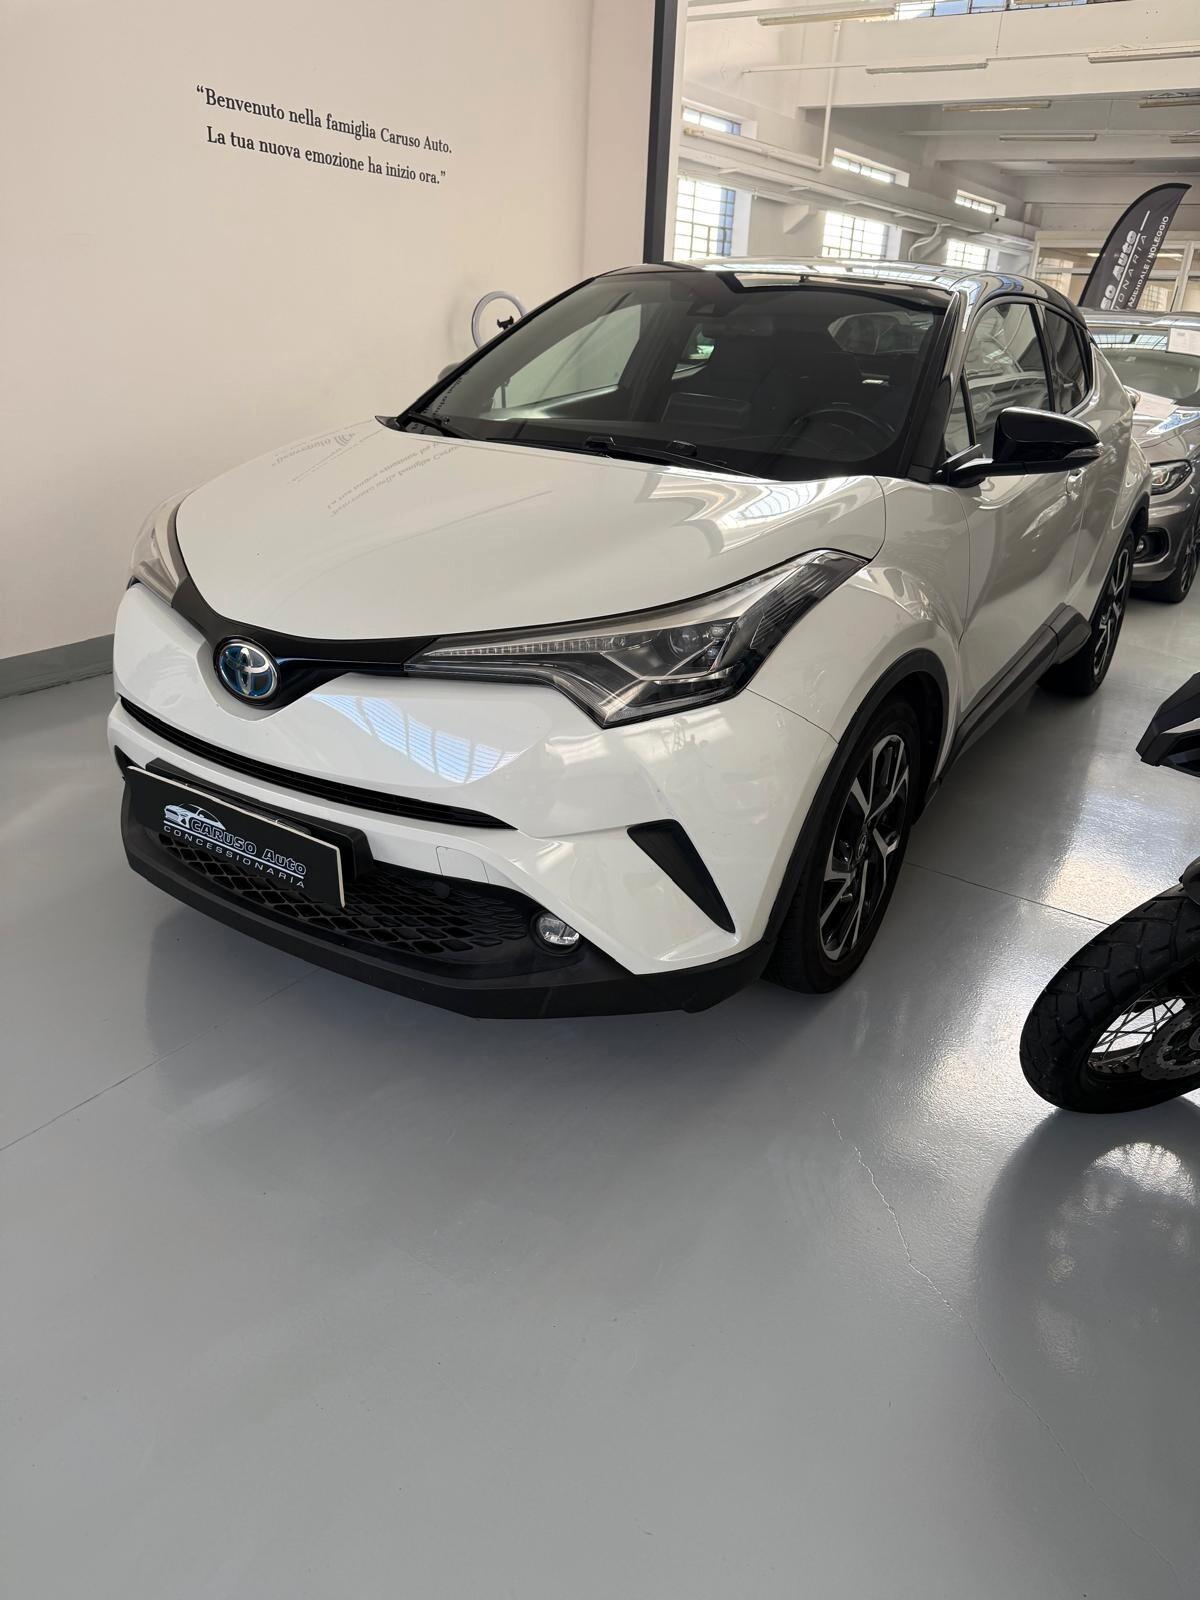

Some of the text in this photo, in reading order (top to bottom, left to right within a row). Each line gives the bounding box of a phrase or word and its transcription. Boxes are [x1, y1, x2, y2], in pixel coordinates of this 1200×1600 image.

[206, 125, 226, 145] La
[230, 131, 255, 151] tua
[258, 140, 301, 160] nuova
[304, 149, 364, 171] emozione
[368, 156, 383, 175] ha
[385, 162, 416, 180] inizio
[289, 108, 322, 128] nella
[325, 113, 376, 141] famiglia
[380, 128, 421, 148] Caruso
[423, 135, 452, 154] Auto.
[1112, 230, 1137, 281] Auto
[1128, 264, 1150, 308] AZIENDALE
[1148, 216, 1169, 259] NOLEGGIO
[163, 825, 305, 889] CONCESSIONARIA
[189, 817, 307, 876] CARUSO Auto
